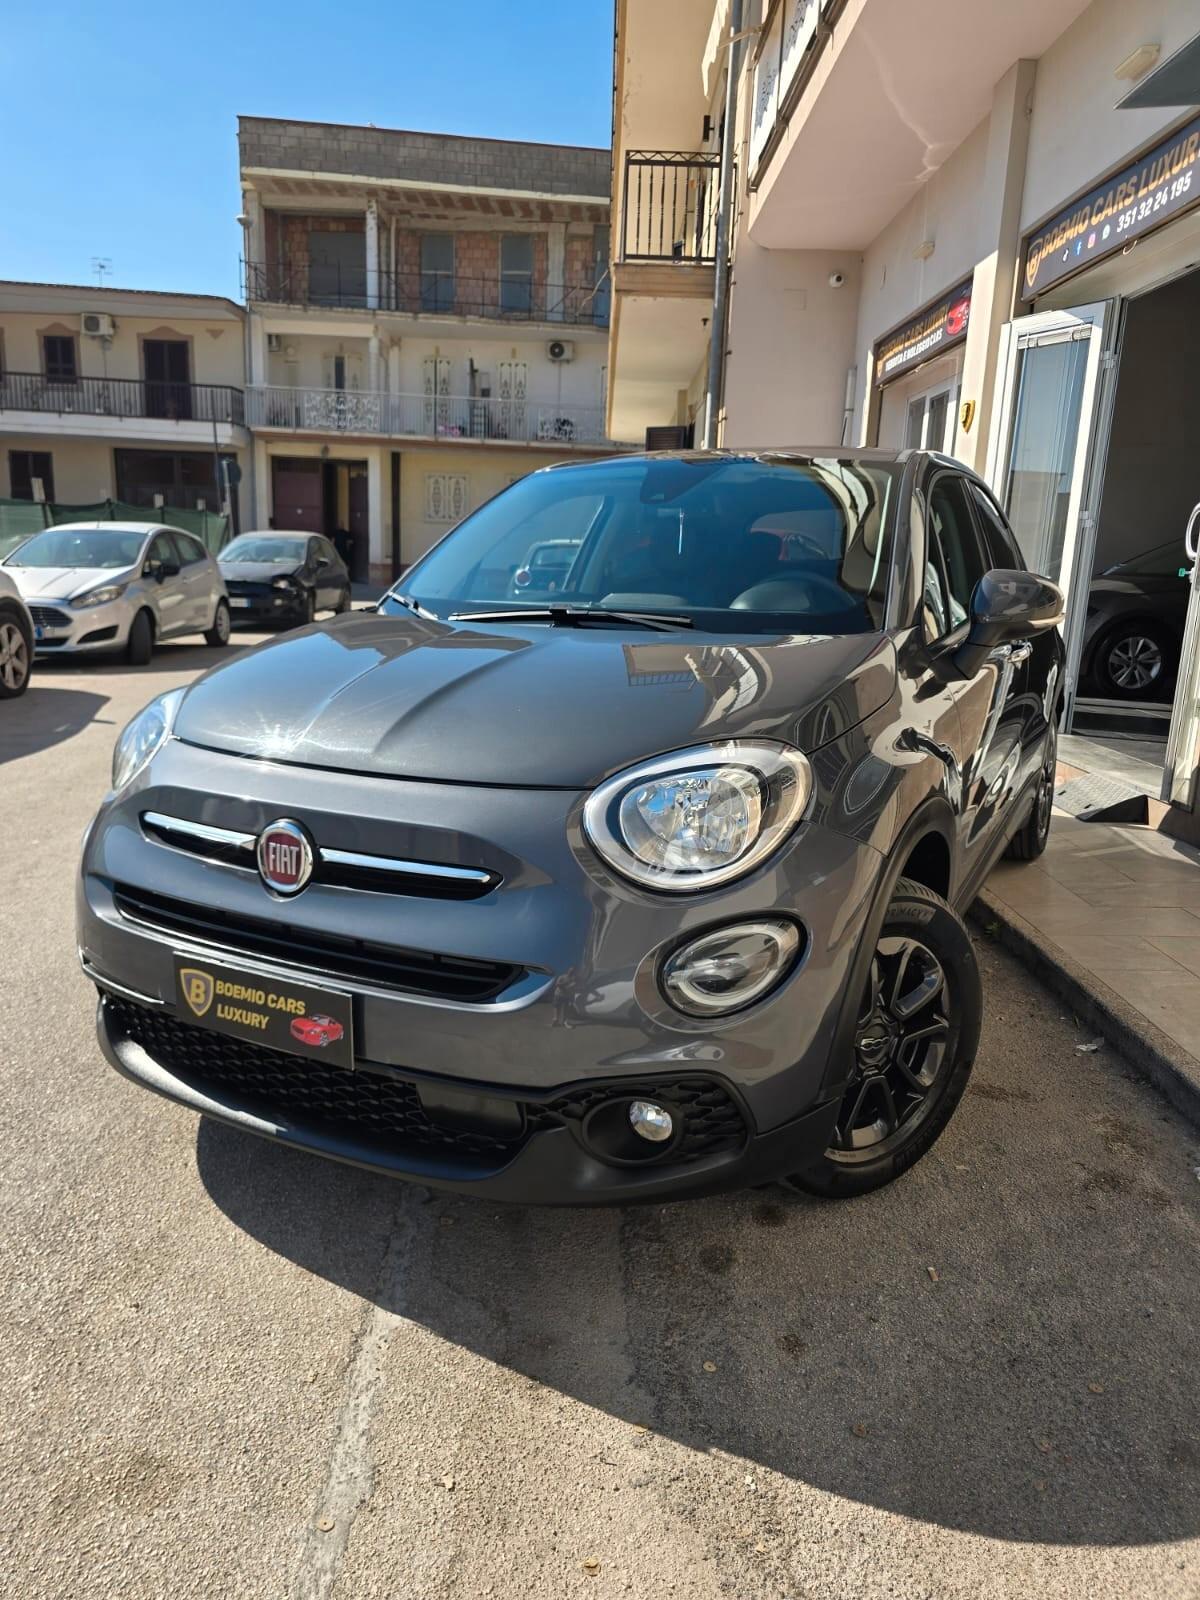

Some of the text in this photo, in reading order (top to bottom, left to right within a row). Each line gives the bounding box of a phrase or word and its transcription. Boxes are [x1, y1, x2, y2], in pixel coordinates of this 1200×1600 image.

[1091, 175, 1137, 226] CARS
[1138, 132, 1200, 198] LUXUR
[1116, 206, 1138, 232] 351
[1137, 197, 1153, 220] 32
[1170, 170, 1192, 200] 195
[268, 841, 300, 876] FIAT
[190, 978, 206, 1004] B
[215, 980, 306, 1015] BOEMIO CARS
[216, 1004, 269, 1030] LUXURY
